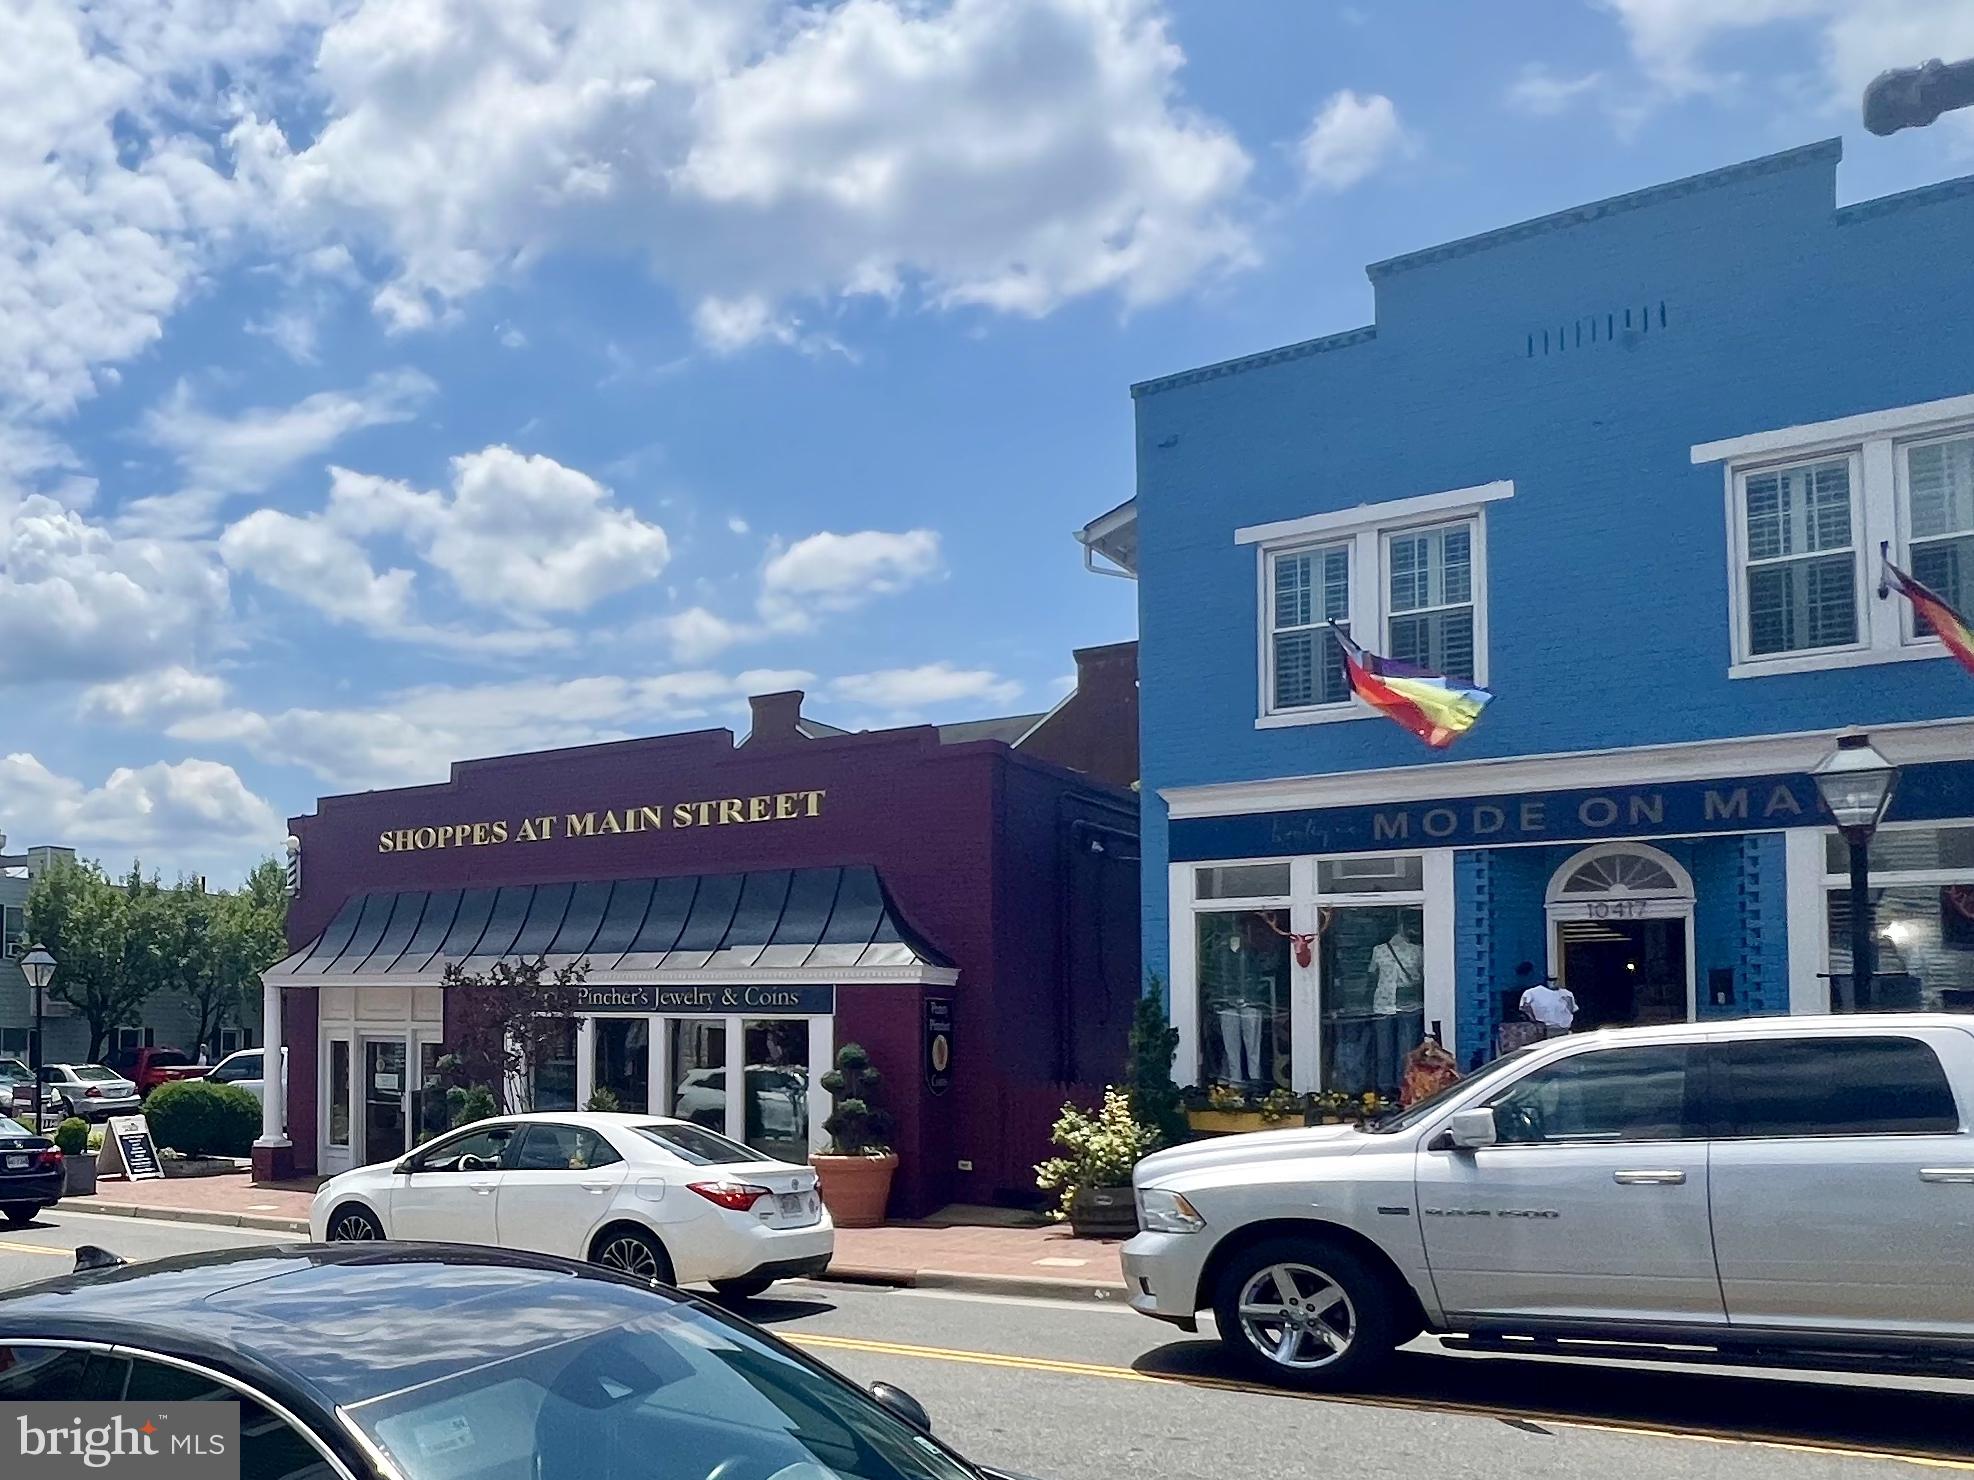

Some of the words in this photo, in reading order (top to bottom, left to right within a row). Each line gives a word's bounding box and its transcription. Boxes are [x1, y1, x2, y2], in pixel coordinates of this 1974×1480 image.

[378, 820, 509, 853] SHOPPES
[514, 815, 557, 842] AT
[563, 804, 664, 838] MAIN
[672, 789, 826, 829] STREET
[1373, 801, 1546, 841] MODE
[1578, 794, 1664, 828] ON
[1587, 901, 1647, 918] 10417
[577, 986, 649, 1006] Pincher's
[650, 986, 716, 1010] Jewelry
[721, 987, 739, 1005] &
[744, 986, 800, 1006] Coins
